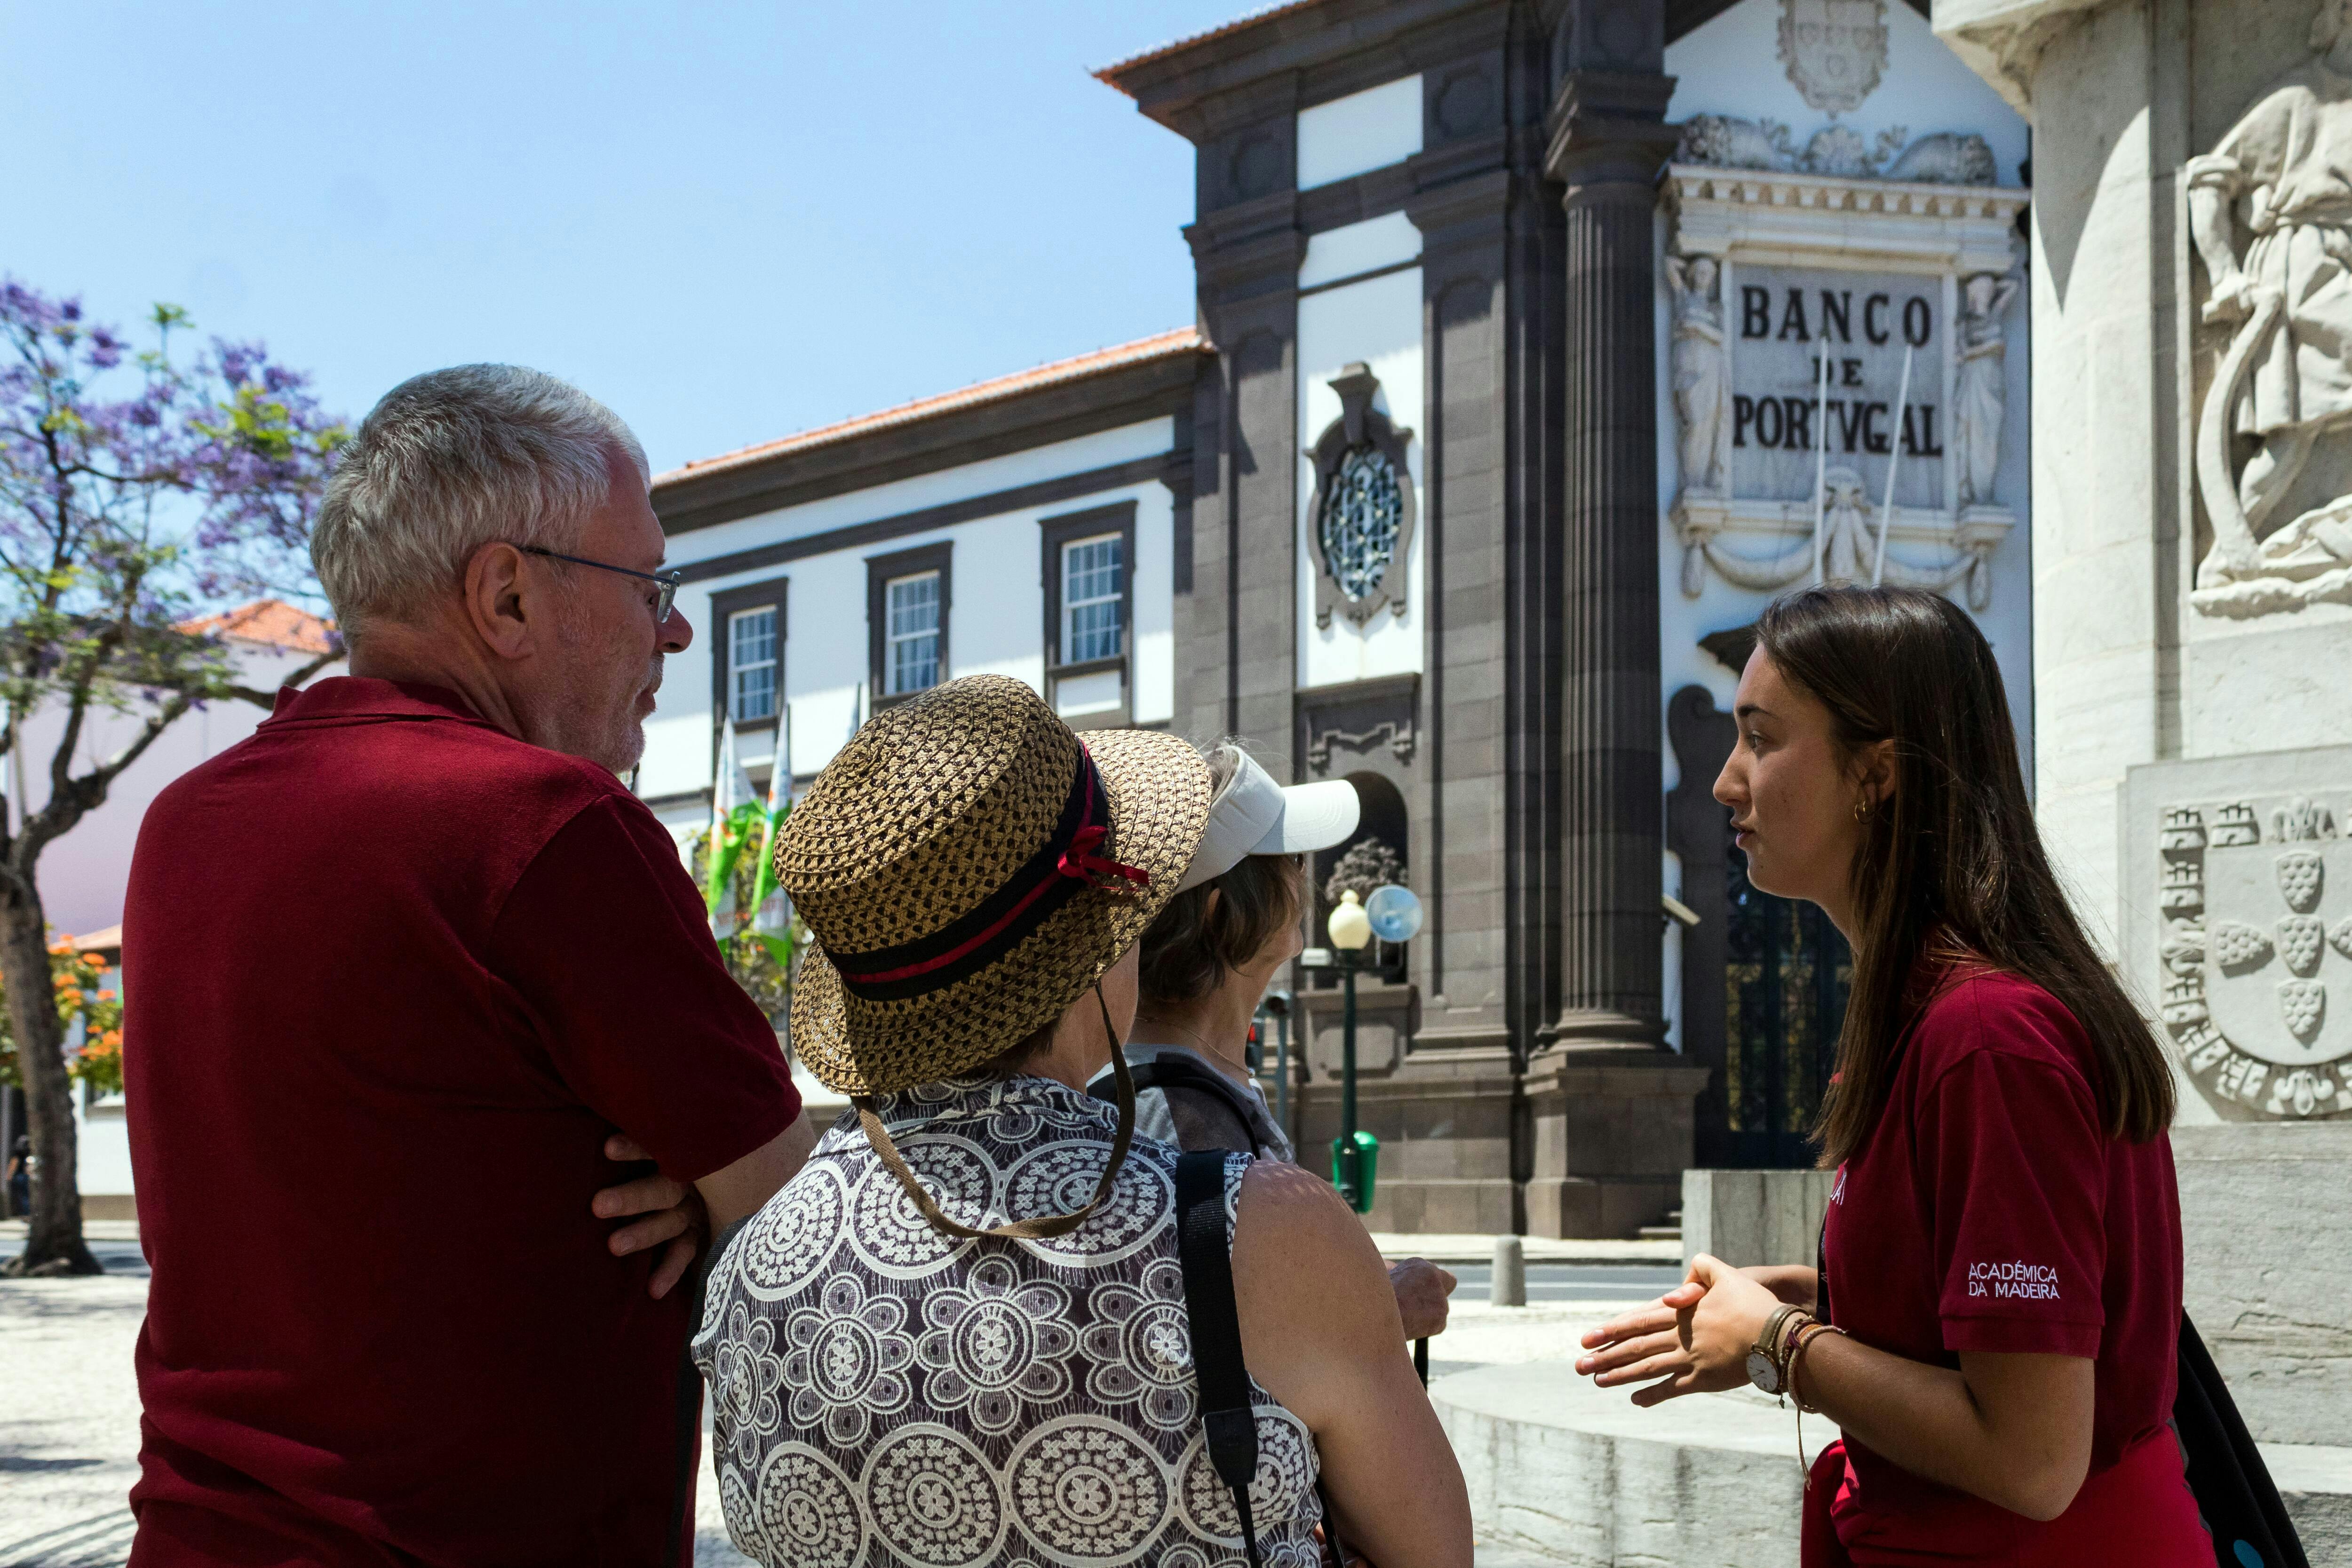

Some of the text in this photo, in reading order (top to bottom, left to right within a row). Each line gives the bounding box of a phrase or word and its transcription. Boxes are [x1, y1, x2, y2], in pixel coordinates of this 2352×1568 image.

[1741, 285, 1932, 348] BANCO
[1812, 356, 1864, 387] DE
[1969, 1260, 2058, 1283] ACADÉMICA
[1969, 1281, 2060, 1299] DA MADEIRA
